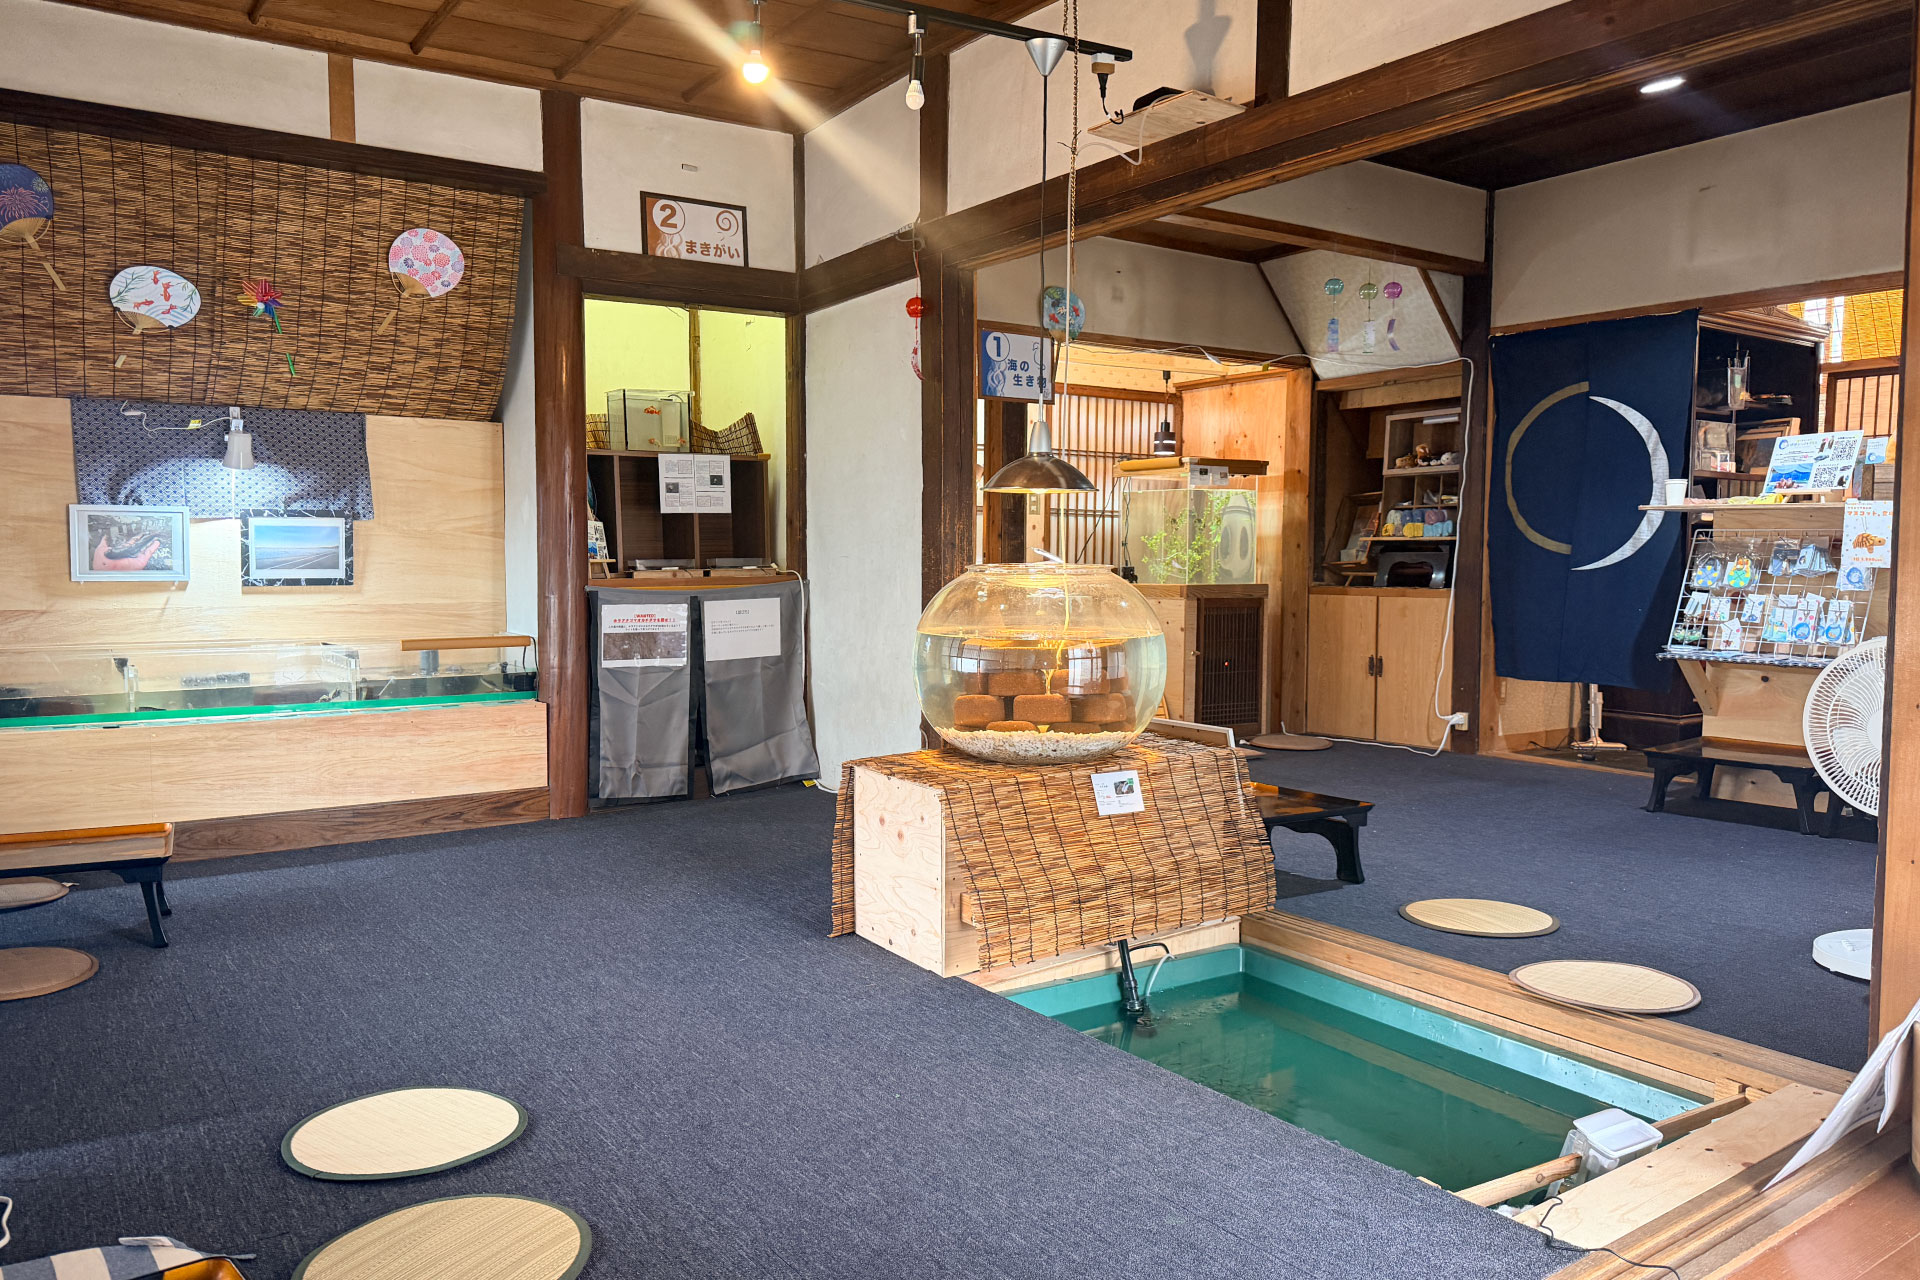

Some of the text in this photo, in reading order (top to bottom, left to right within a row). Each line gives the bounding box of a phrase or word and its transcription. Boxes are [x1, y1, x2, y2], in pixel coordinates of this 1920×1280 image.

[660, 203, 677, 228] 2
[685, 240, 740, 258] まきがい
[993, 336, 1001, 357] 1
[1007, 358, 1029, 372] 海の
